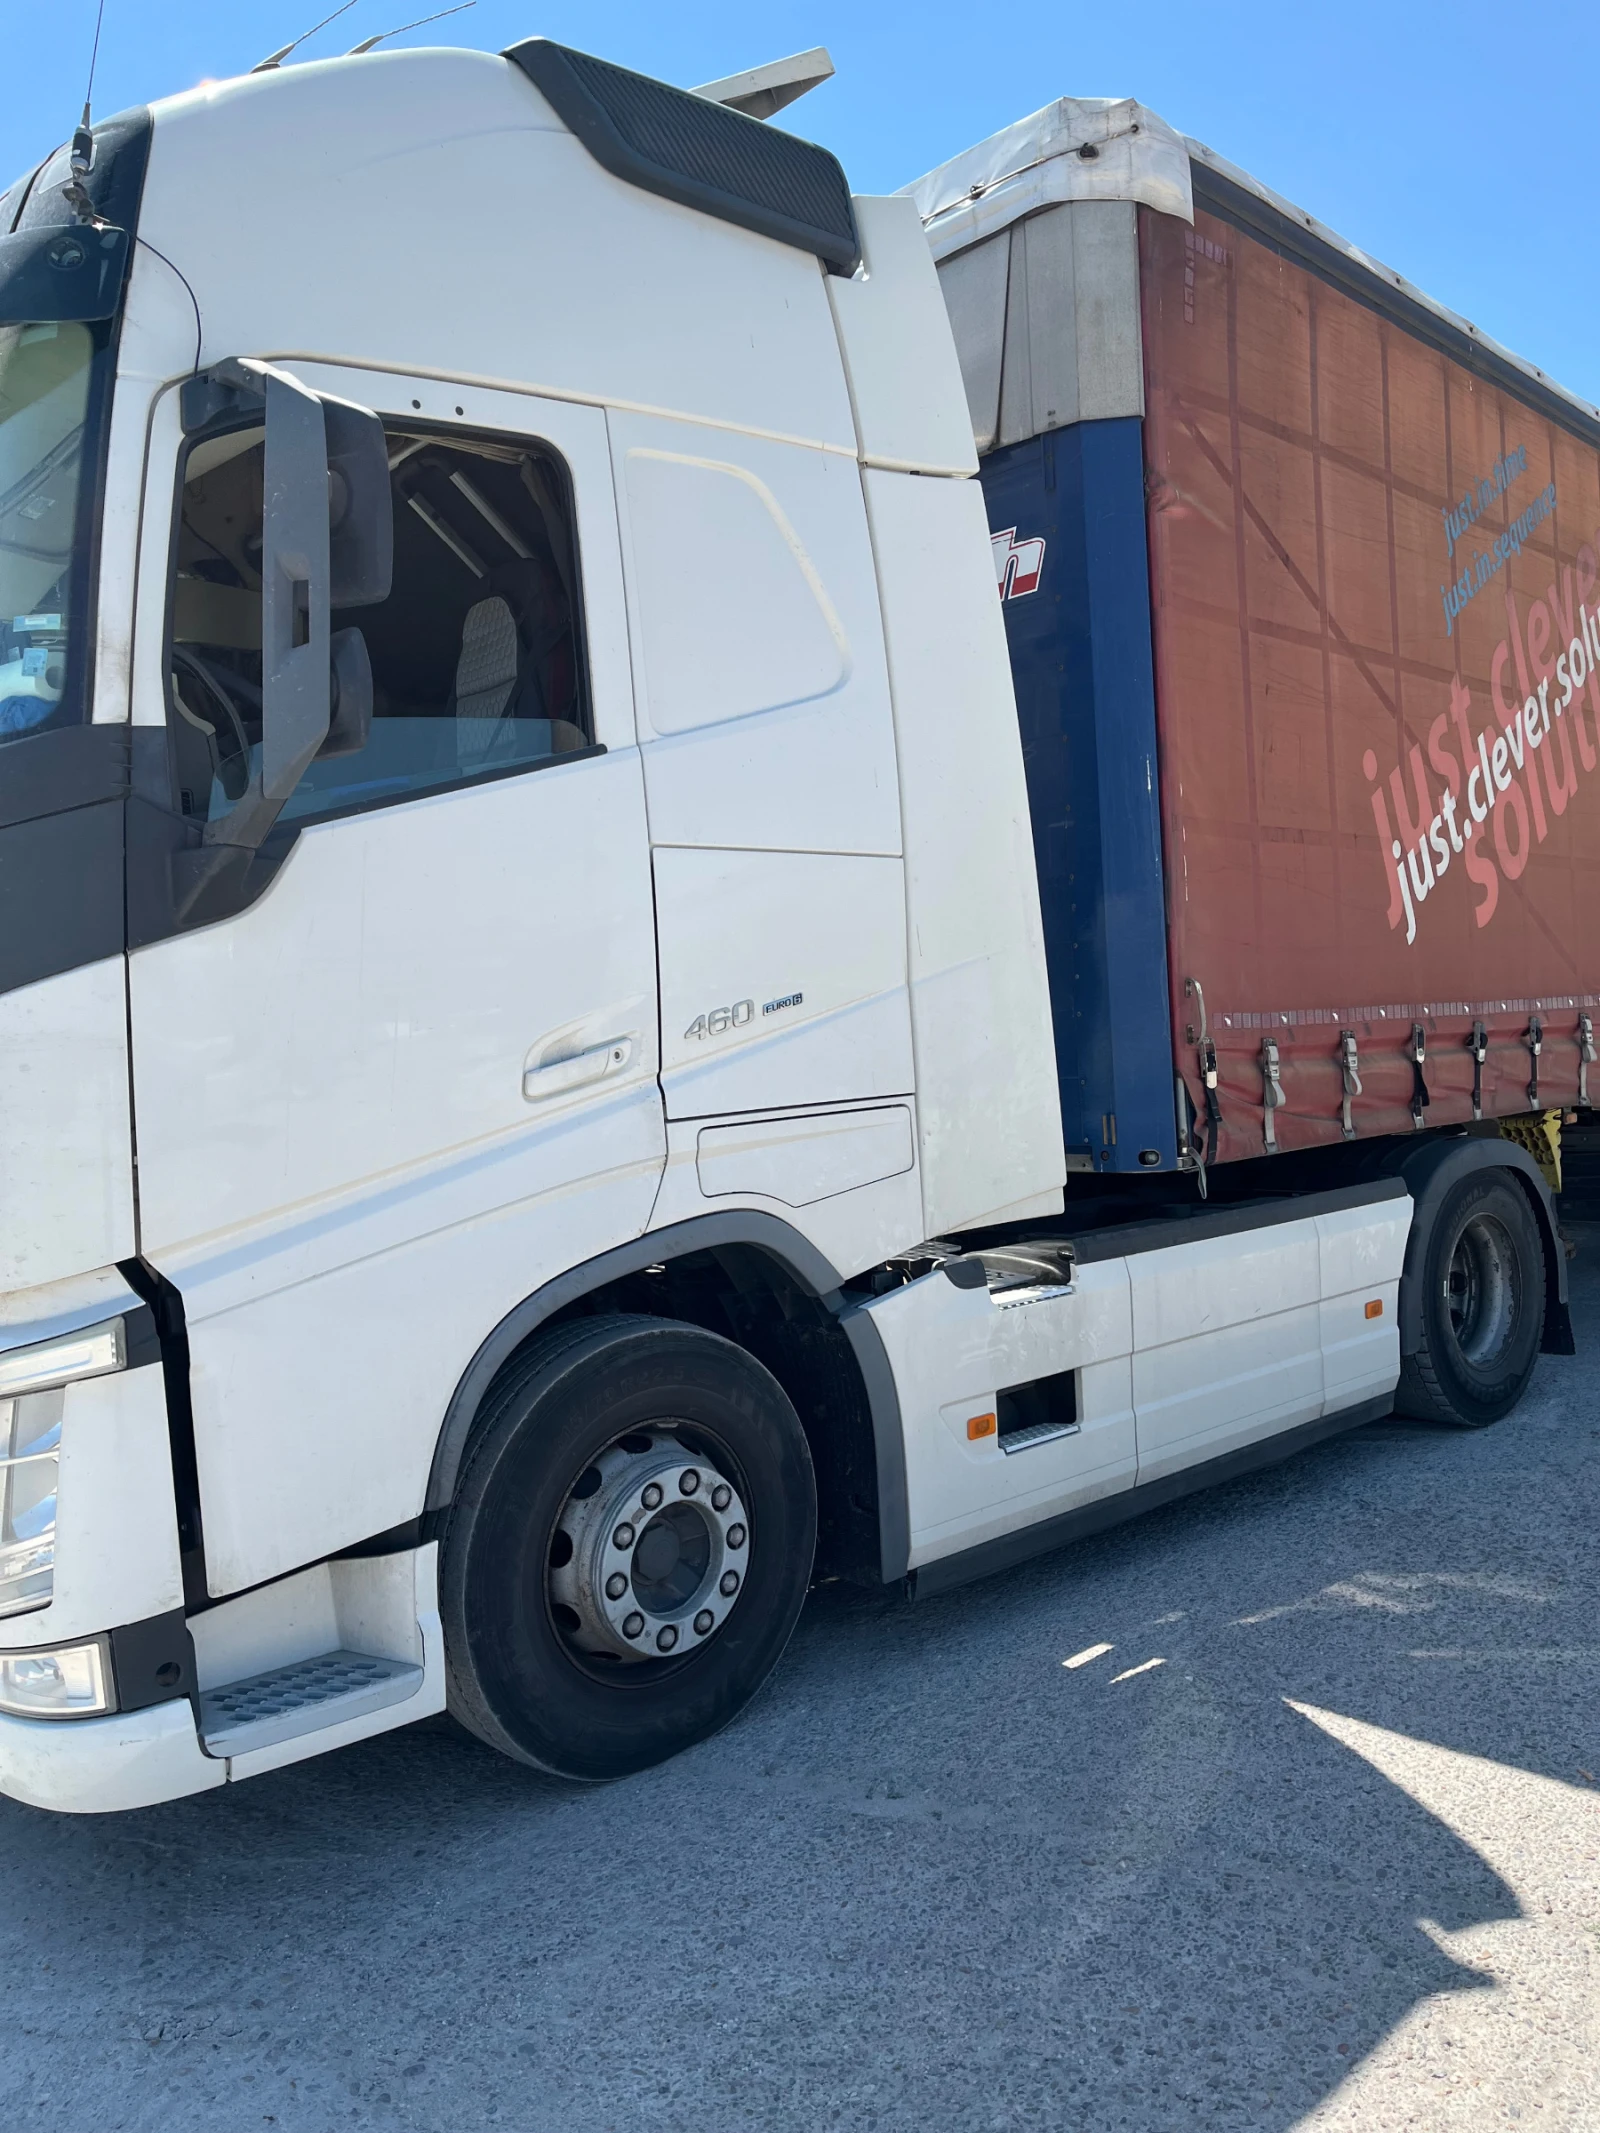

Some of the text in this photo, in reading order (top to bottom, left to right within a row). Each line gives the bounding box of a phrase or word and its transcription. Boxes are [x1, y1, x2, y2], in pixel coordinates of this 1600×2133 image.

[1440, 482, 1556, 636] just.in.sequence
[1441, 444, 1527, 557] just.in.time
[1362, 526, 1600, 930] just.cleve
[684, 999, 755, 1041] 460
